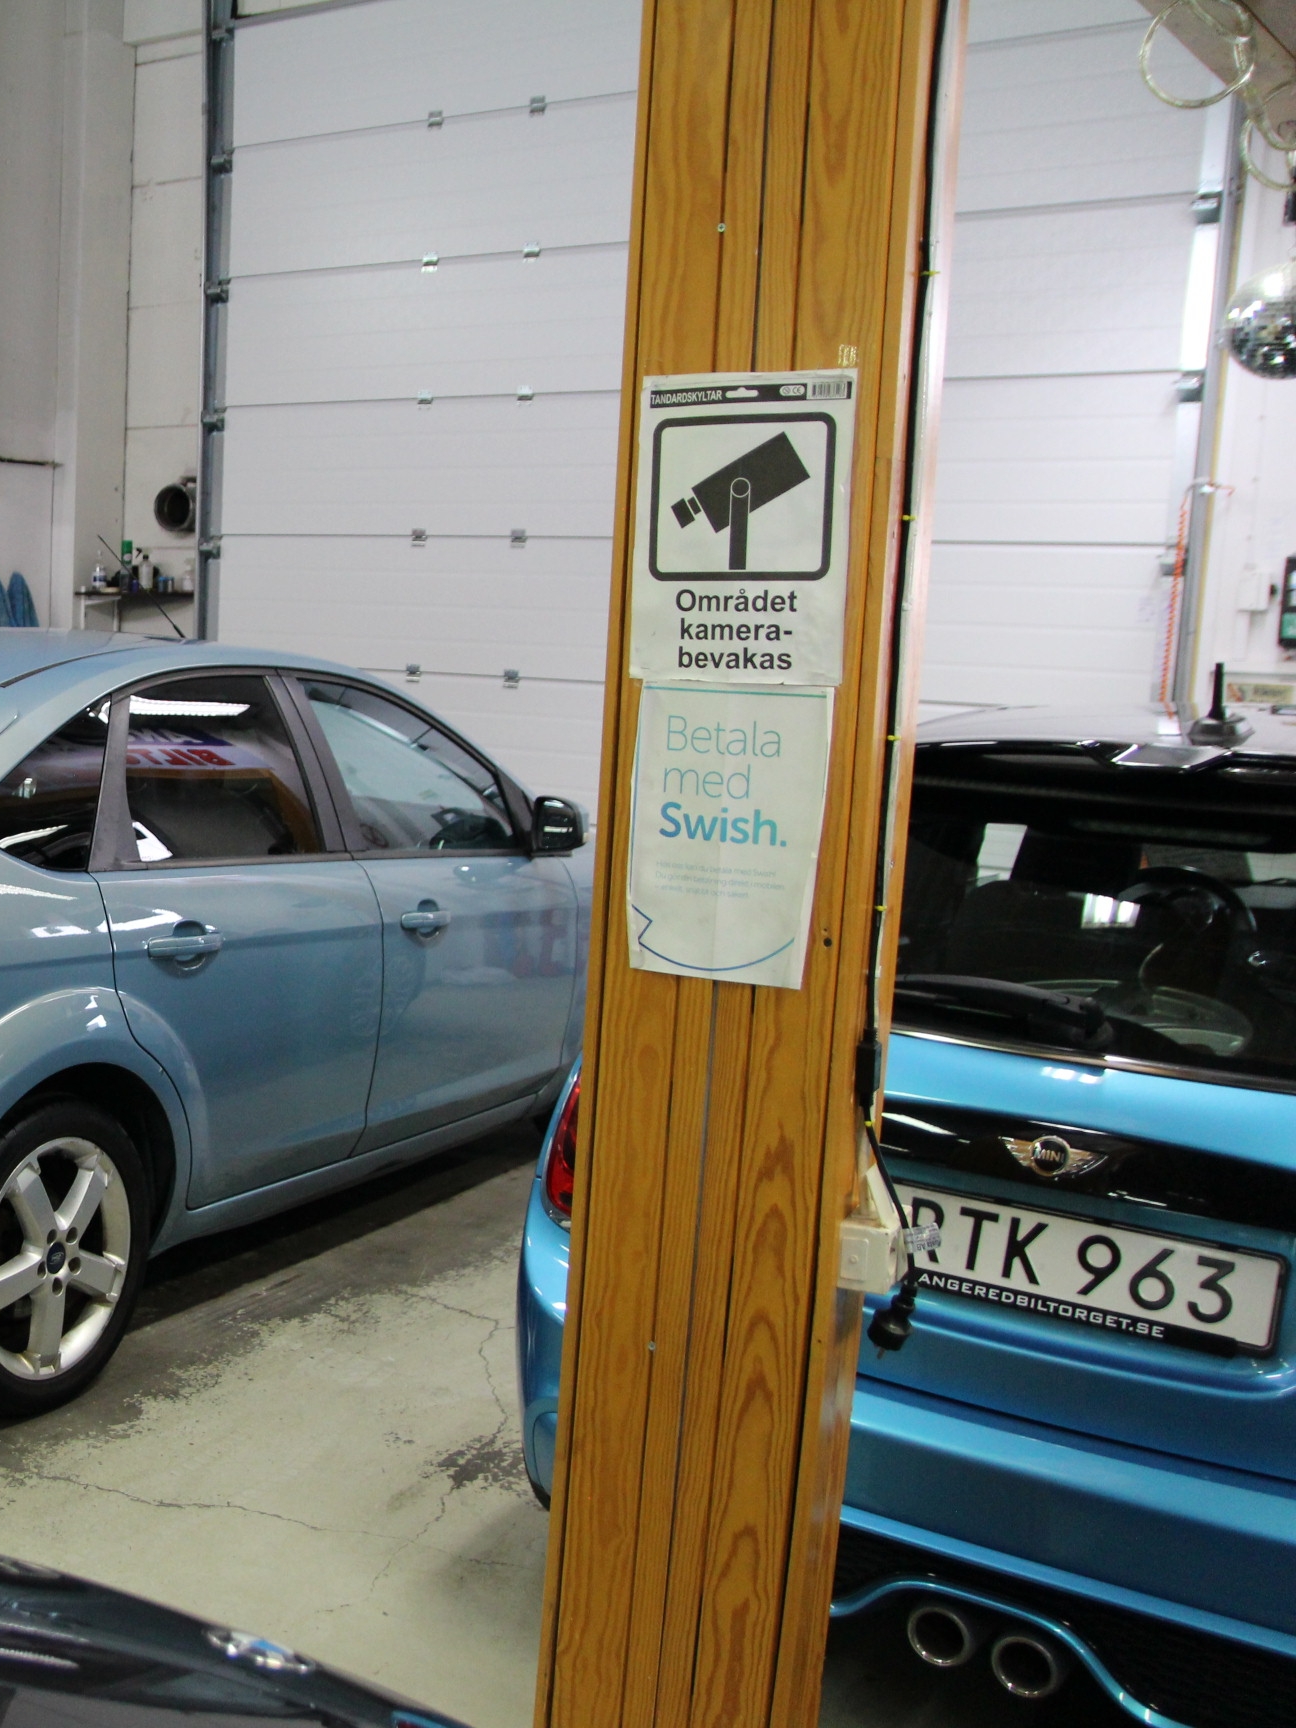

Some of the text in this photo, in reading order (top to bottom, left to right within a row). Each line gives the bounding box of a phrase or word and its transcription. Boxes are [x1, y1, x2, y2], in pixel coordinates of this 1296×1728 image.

[675, 588, 797, 613] Området
[680, 618, 793, 641] kamera-
[678, 646, 793, 670] bevakas
[666, 715, 781, 757] Betala
[663, 764, 751, 799] med
[659, 801, 787, 848] Swish.
[1034, 1147, 1064, 1163] MINI
[911, 1196, 1237, 1325] RTK 963
[917, 1272, 1165, 1340] ANGEREDBILTORGET.SE
